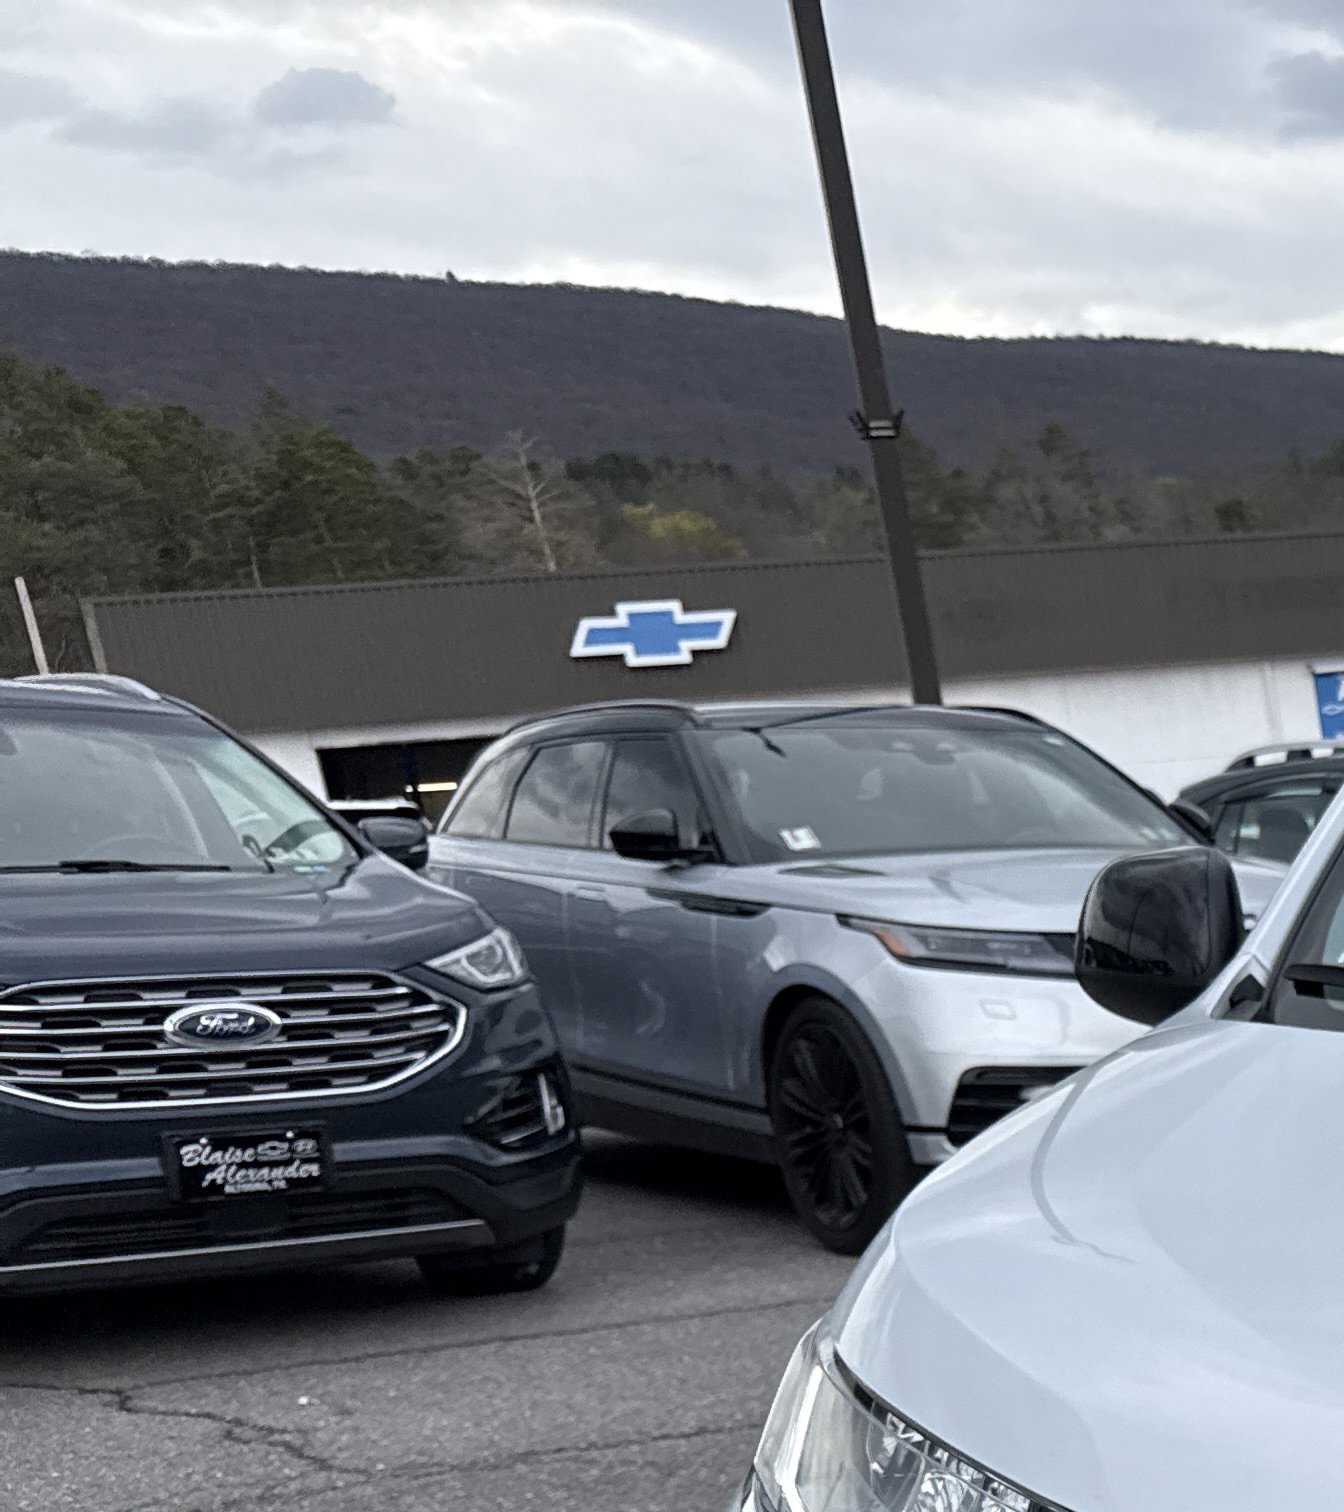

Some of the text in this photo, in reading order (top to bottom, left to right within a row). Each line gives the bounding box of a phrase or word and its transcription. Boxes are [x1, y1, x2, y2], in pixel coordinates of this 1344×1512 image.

[196, 1012, 255, 1035] Ford
[179, 1143, 257, 1168] Blaise
[202, 1160, 321, 1187] Alexander
